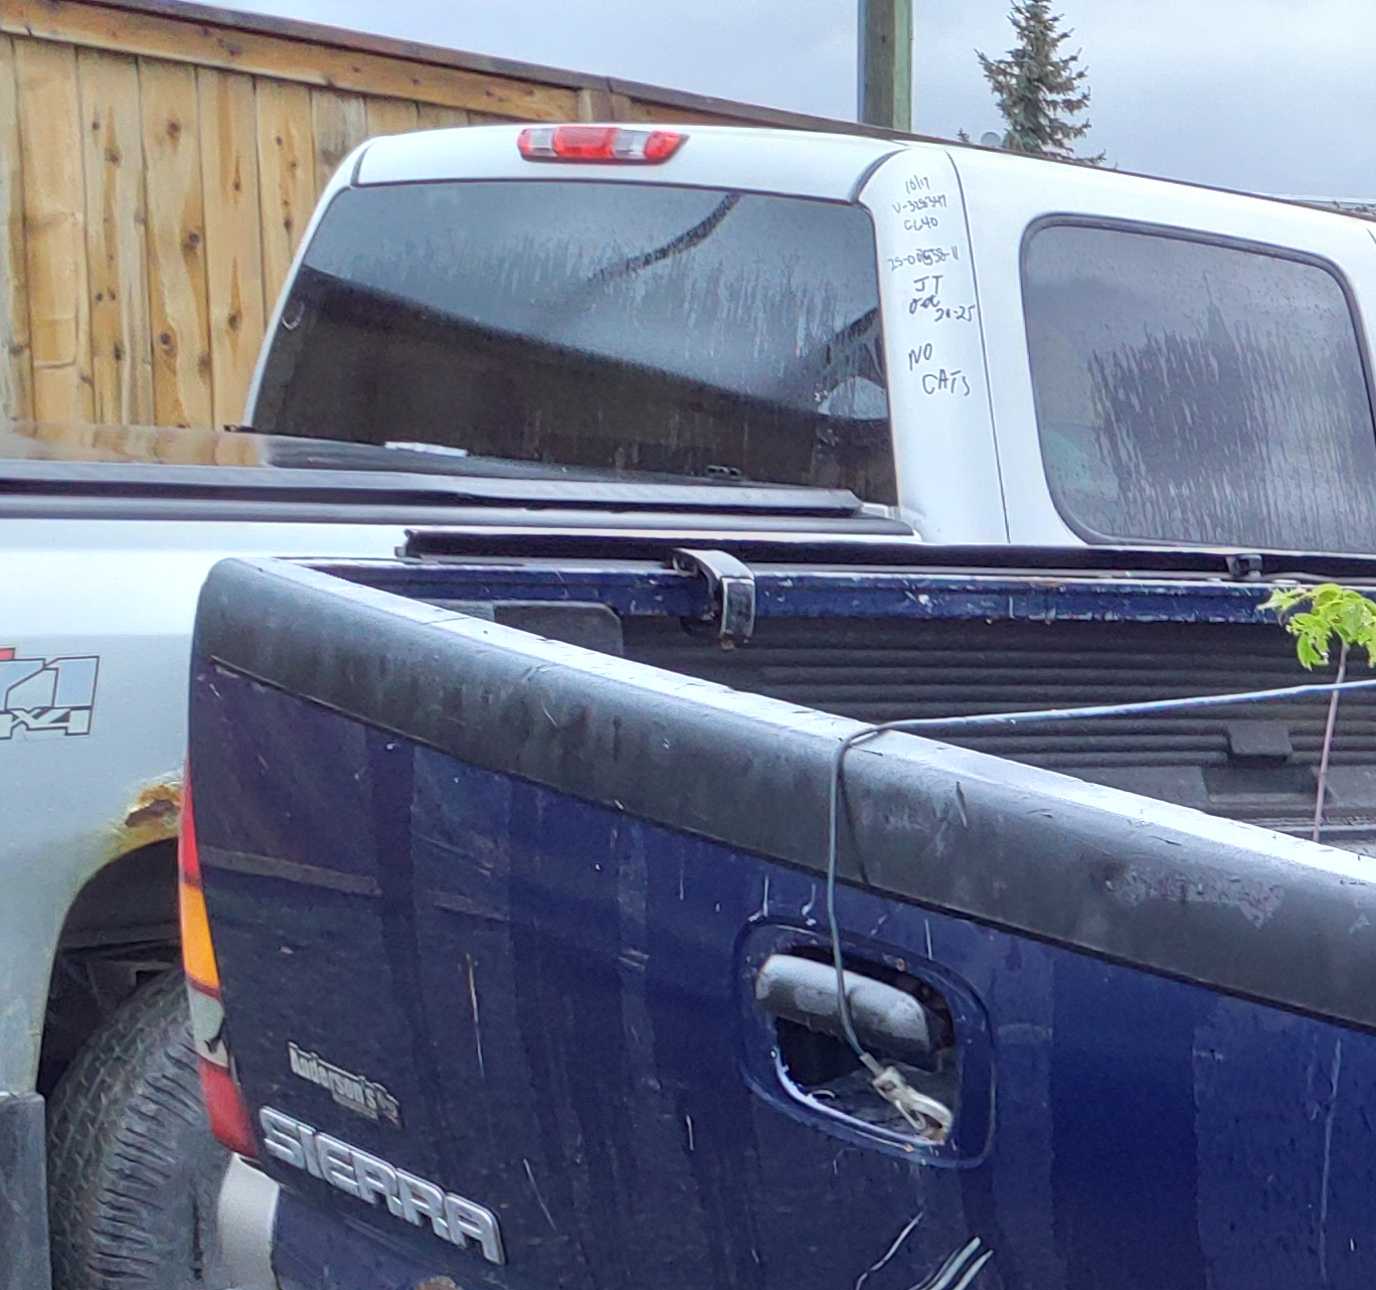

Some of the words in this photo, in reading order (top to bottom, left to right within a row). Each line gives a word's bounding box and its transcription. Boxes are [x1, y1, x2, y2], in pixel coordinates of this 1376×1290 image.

[907, 342, 933, 371] NO
[922, 368, 971, 397] CATS
[259, 1104, 505, 1265] SIERRA
